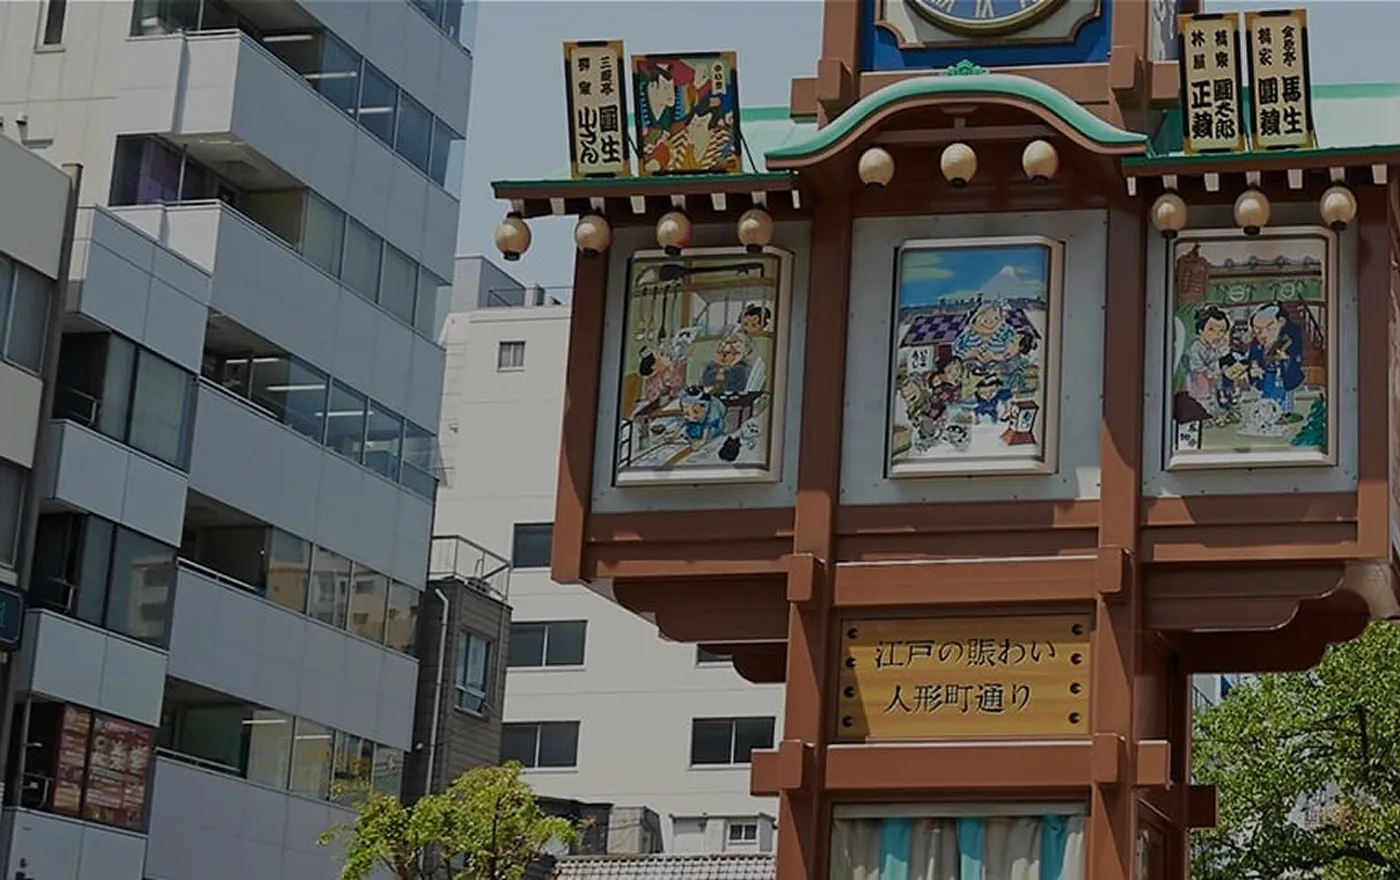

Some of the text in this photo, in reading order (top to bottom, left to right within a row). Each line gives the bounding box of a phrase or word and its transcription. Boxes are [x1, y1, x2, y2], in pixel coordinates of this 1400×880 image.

[875, 638, 1057, 669] 江戸の賑わい
[883, 683, 1033, 714] 人形町通り
